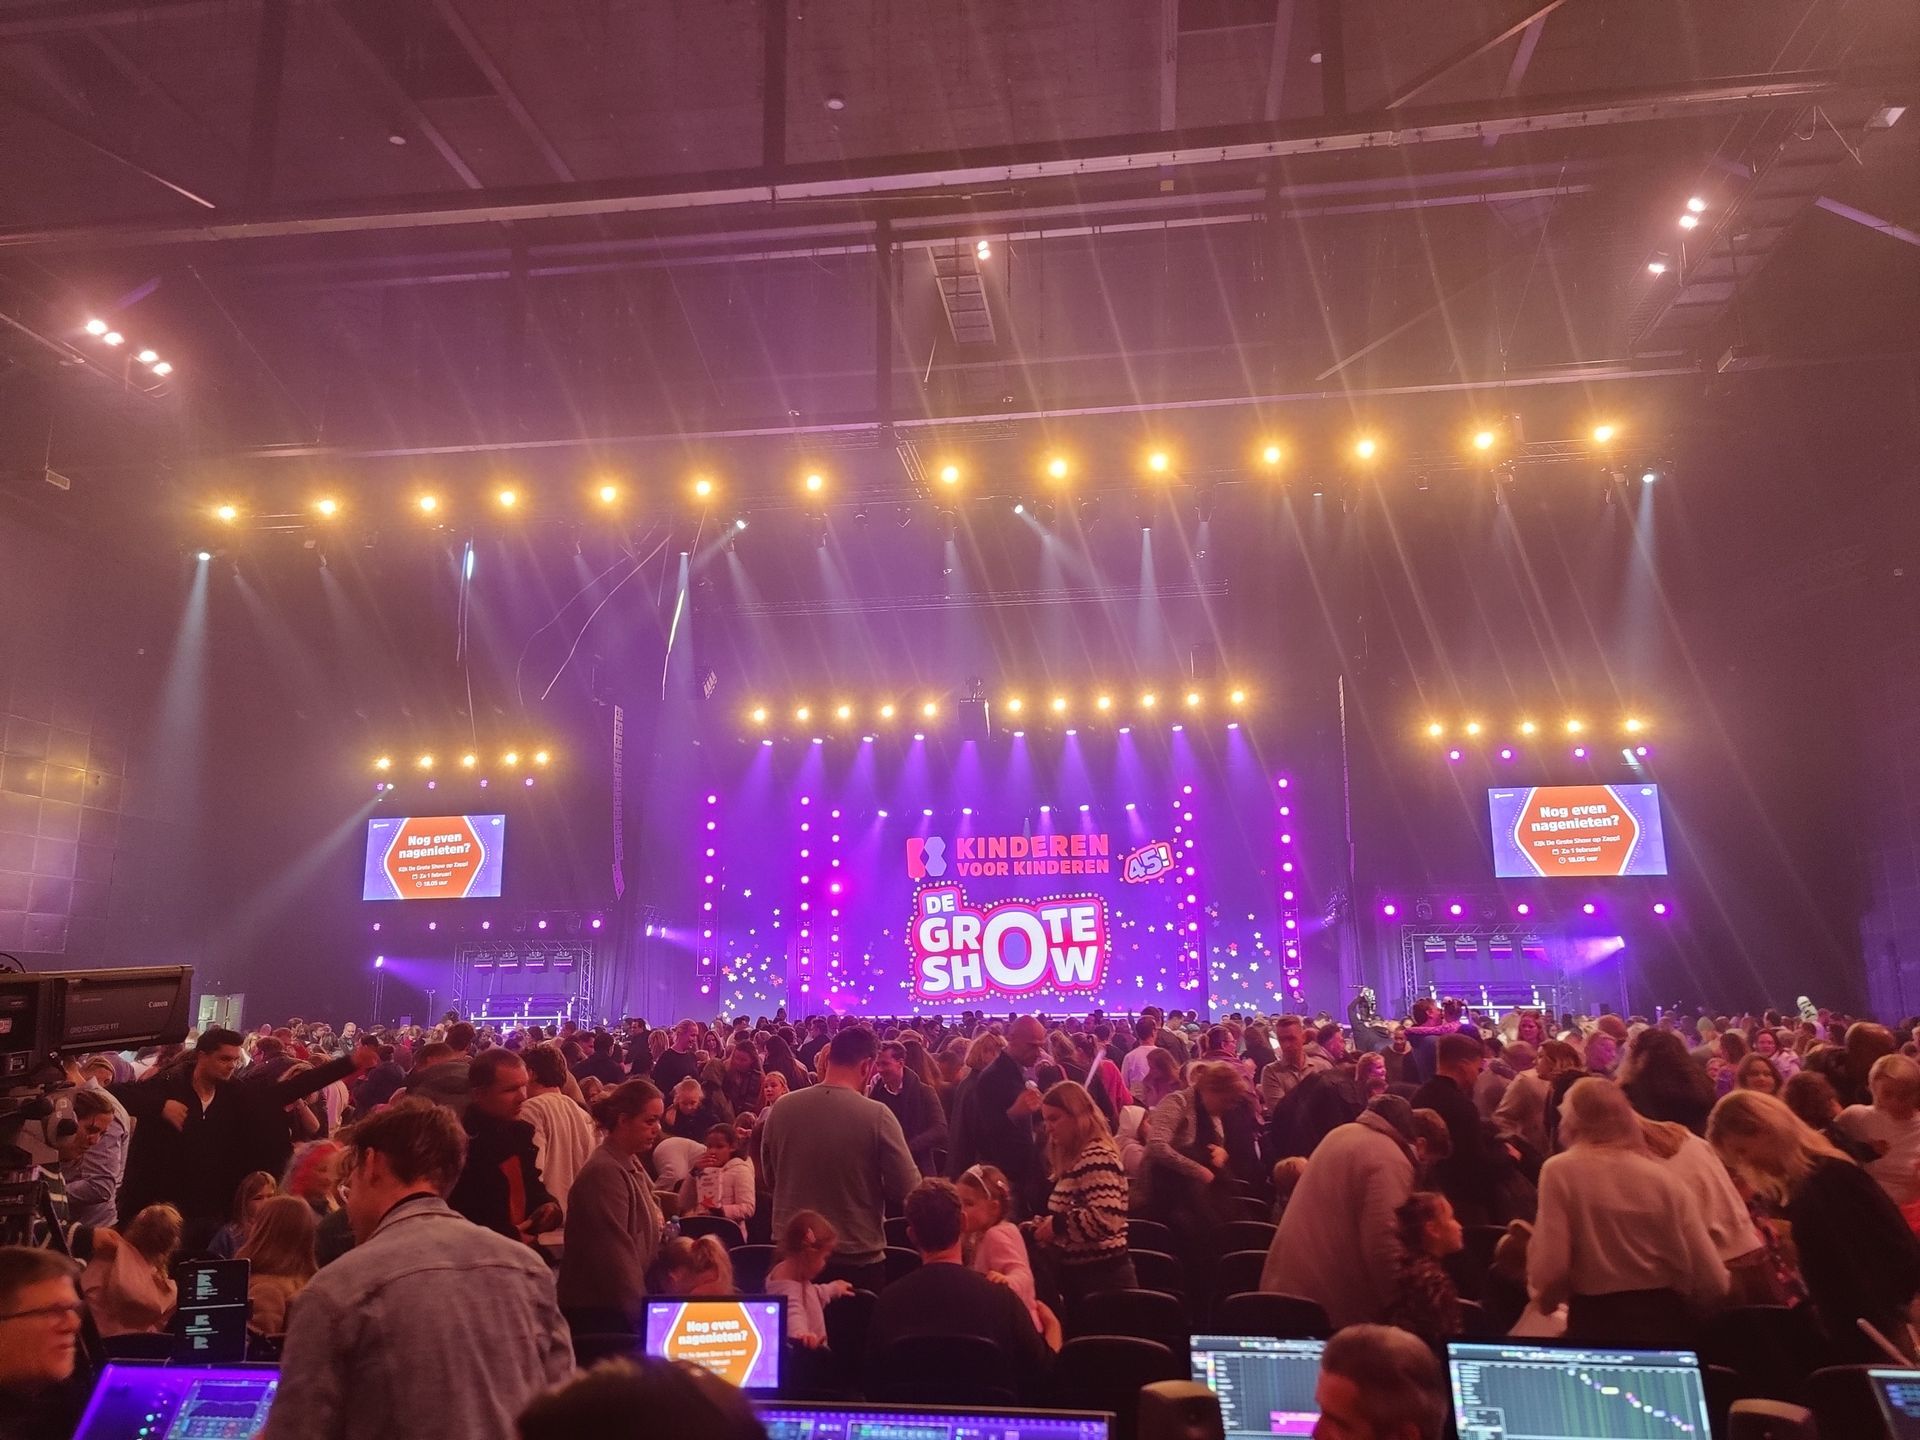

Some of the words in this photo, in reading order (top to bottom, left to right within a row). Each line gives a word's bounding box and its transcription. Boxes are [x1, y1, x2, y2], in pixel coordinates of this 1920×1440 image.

[1540, 806, 1568, 818] Nog
[1571, 804, 1607, 815] even
[1531, 815, 1620, 832] nagenieten?
[408, 835, 431, 846] Nog
[433, 833, 462, 843] even
[957, 834, 1109, 859] KINDEREN
[399, 843, 471, 859] nagenieten?
[957, 861, 1009, 876] VOOR
[1014, 859, 1109, 875] KINDEREN
[1128, 846, 1171, 880] 45!
[926, 894, 955, 914] DE
[919, 906, 1098, 985] GROTE
[922, 911, 1098, 992] SHOW
